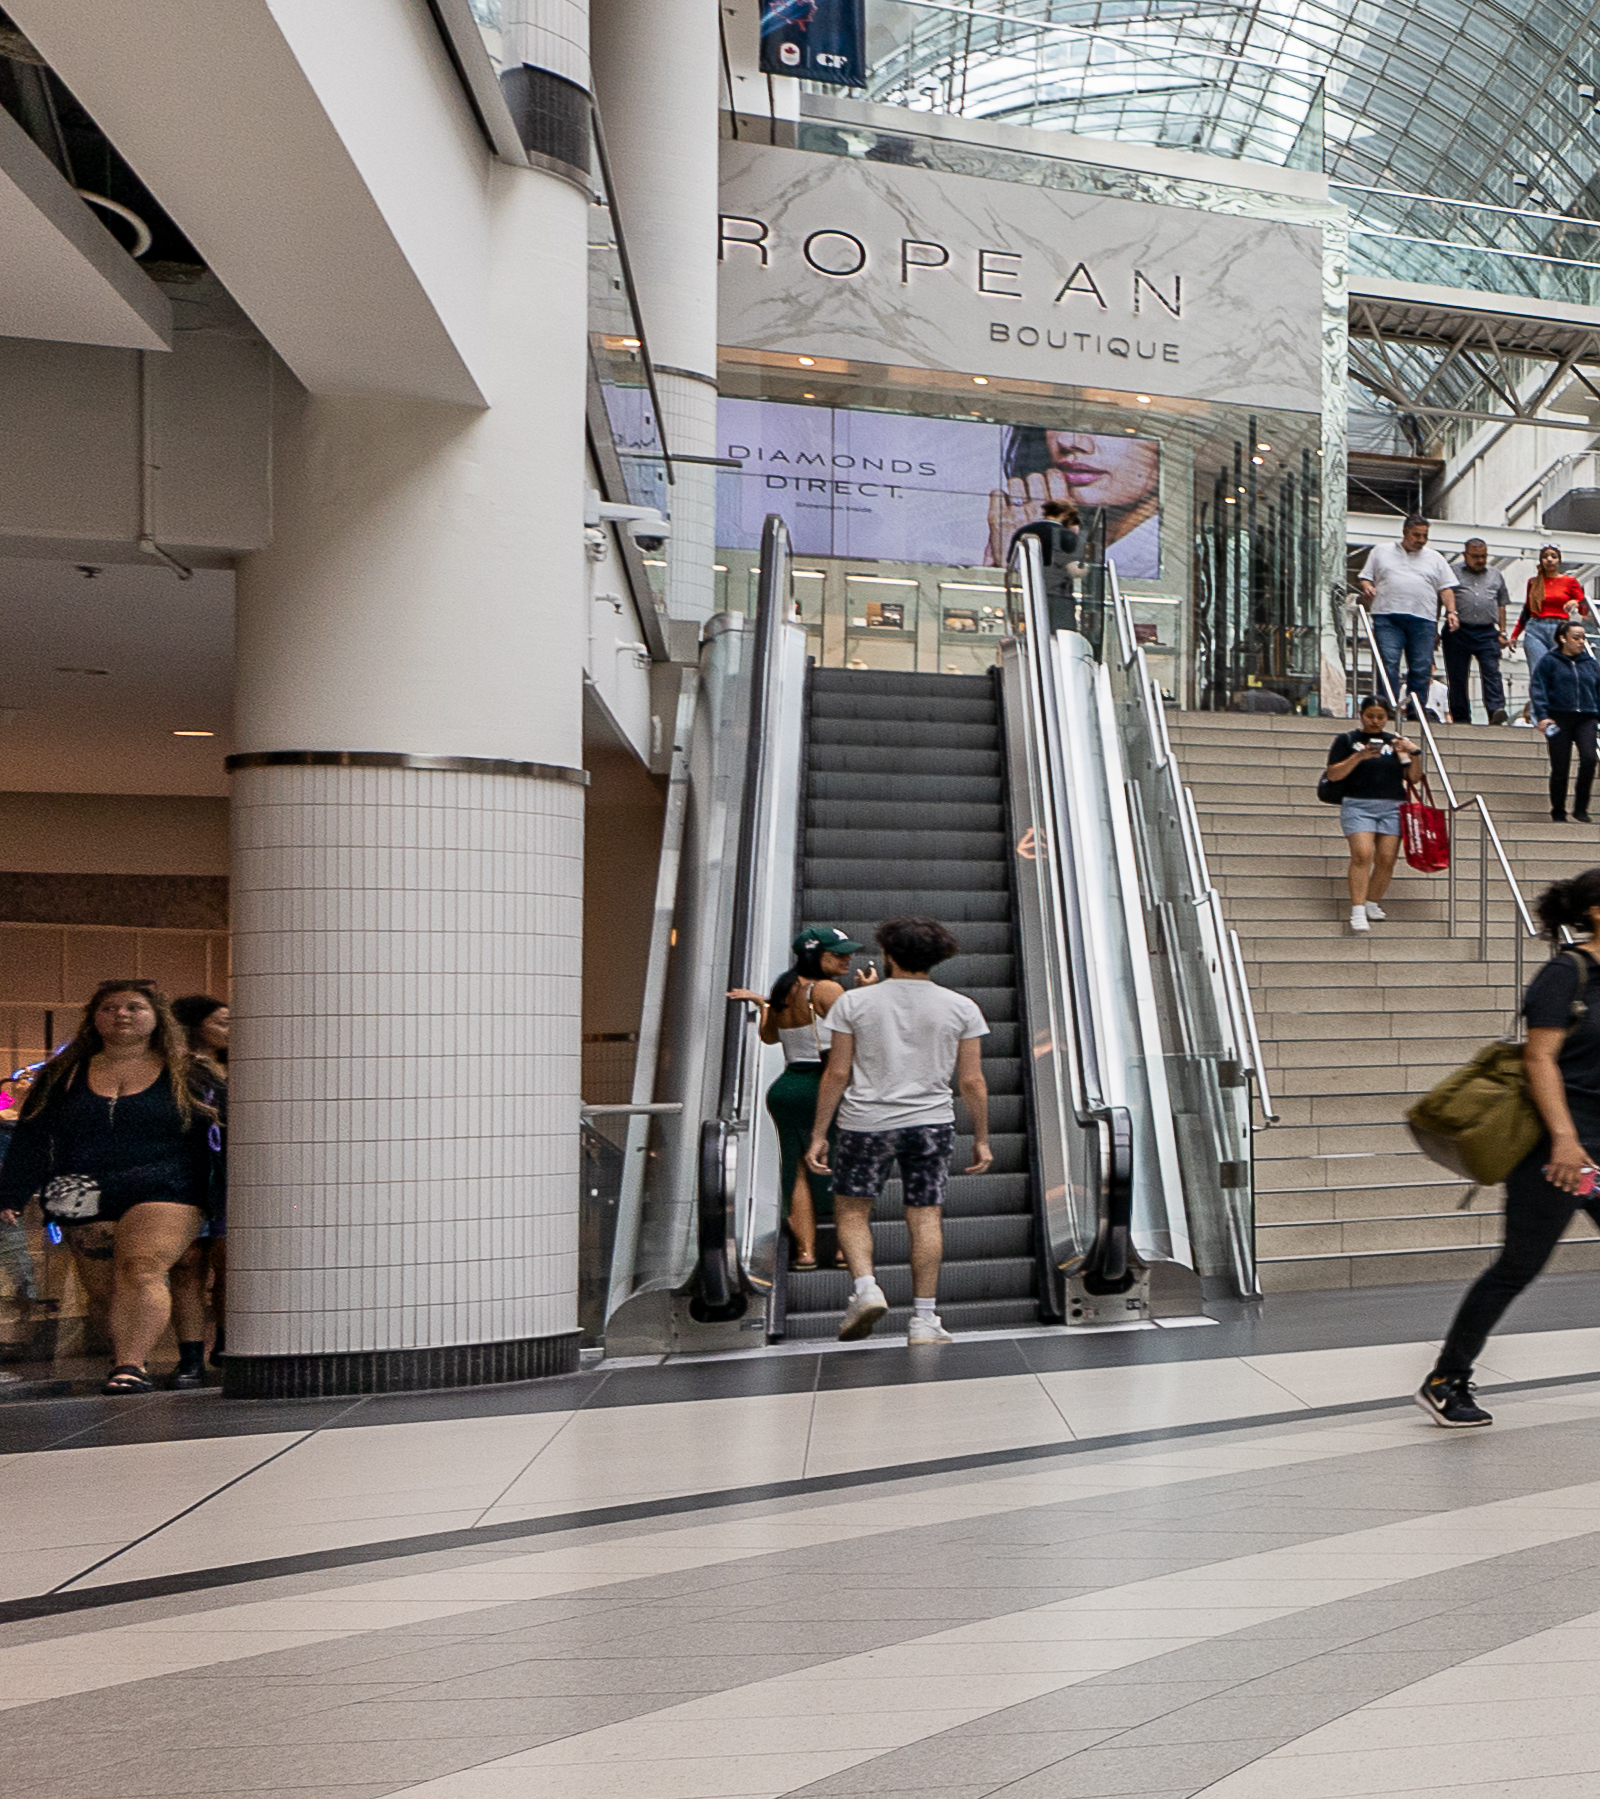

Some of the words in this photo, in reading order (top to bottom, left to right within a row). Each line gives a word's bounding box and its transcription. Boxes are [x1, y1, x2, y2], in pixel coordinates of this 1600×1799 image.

[816, 53, 848, 69] CF
[717, 213, 1182, 318] ROPEAN
[990, 322, 1180, 364] BOUTIQUE
[728, 444, 937, 477] DIAMONDS
[765, 474, 904, 500] DIRECT.
